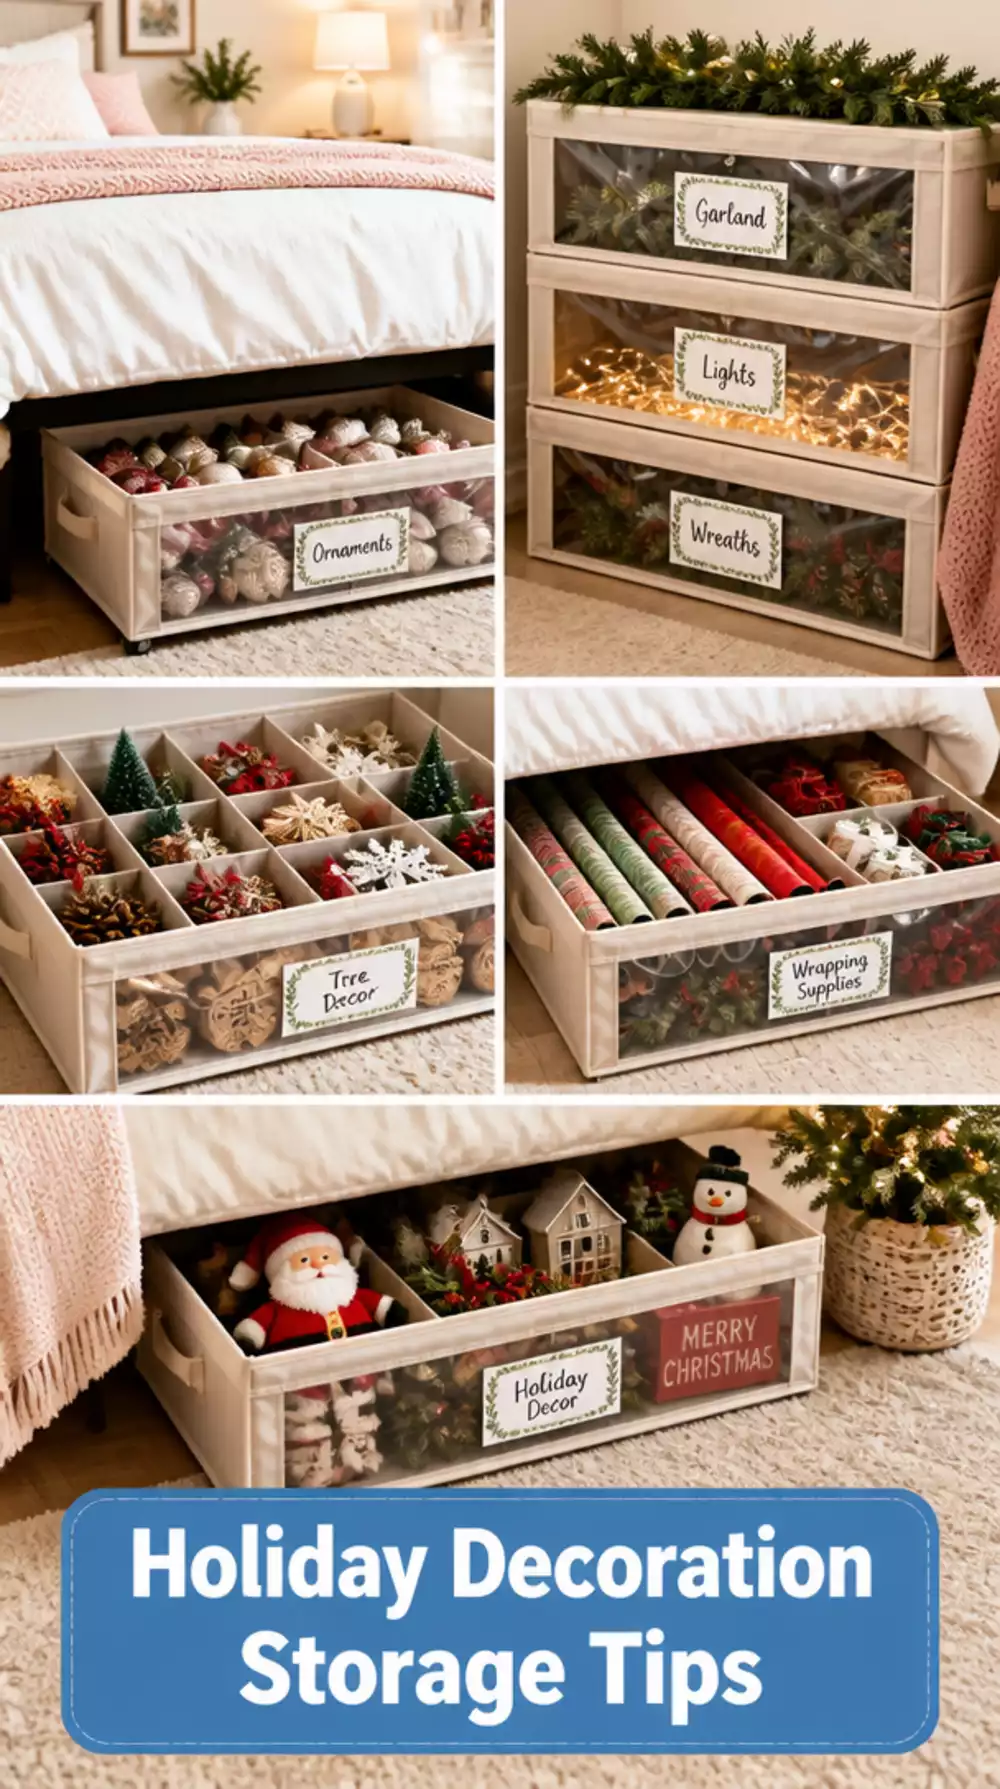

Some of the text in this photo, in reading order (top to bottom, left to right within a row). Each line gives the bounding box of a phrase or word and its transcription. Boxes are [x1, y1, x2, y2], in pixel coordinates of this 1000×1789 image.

[695, 197, 767, 230] Garland
[702, 354, 757, 390] Lights
[312, 533, 393, 564] Ornaments
[690, 520, 761, 559] Wreaths
[791, 954, 868, 980] Wrapping
[797, 975, 862, 1004] Supplies
[681, 1314, 758, 1352] MERRY
[663, 1345, 775, 1388] CHRISTMAS
[514, 1368, 589, 1404] Holiday
[527, 1395, 579, 1422] Decor
